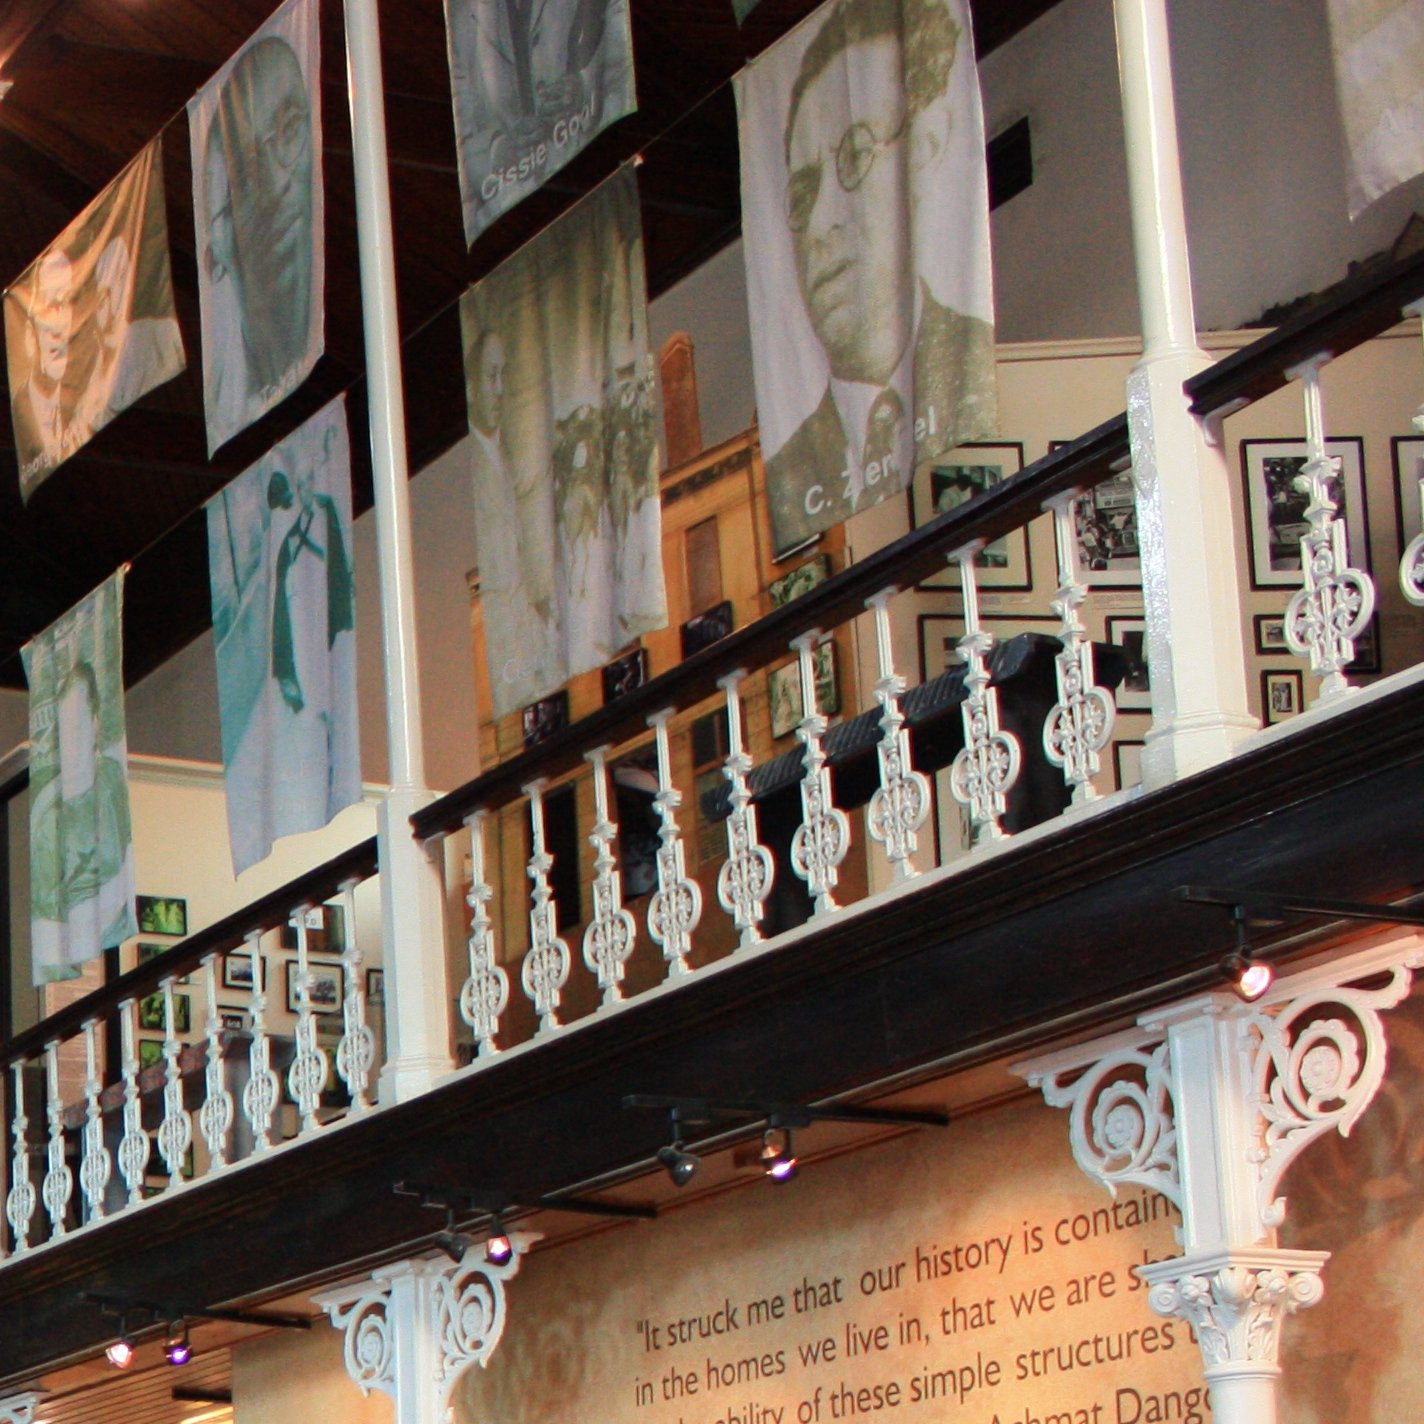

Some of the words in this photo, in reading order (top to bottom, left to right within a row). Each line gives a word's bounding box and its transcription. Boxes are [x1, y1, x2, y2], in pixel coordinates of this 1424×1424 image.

[481, 142, 547, 200] Cissie
[804, 485, 832, 516] C.
[667, 1299, 739, 1346] struck
[747, 1294, 785, 1327] me
[793, 1276, 843, 1314] that
[860, 1261, 907, 1296] our
[915, 1234, 1013, 1283] history
[1023, 1221, 1044, 1255] is
[635, 1377, 654, 1407] in
[662, 1366, 699, 1401] the
[706, 1350, 786, 1391] homes
[798, 1337, 836, 1368] we
[846, 1323, 889, 1357] live
[899, 1312, 930, 1346] in,
[941, 1296, 996, 1337] that
[1009, 1284, 1056, 1319] we
[1066, 1271, 1116, 1307] are
[797, 1387, 823, 1424] of
[830, 1381, 901, 1419] these
[910, 1352, 1001, 1405] simple
[1016, 1320, 1174, 1381] structures
